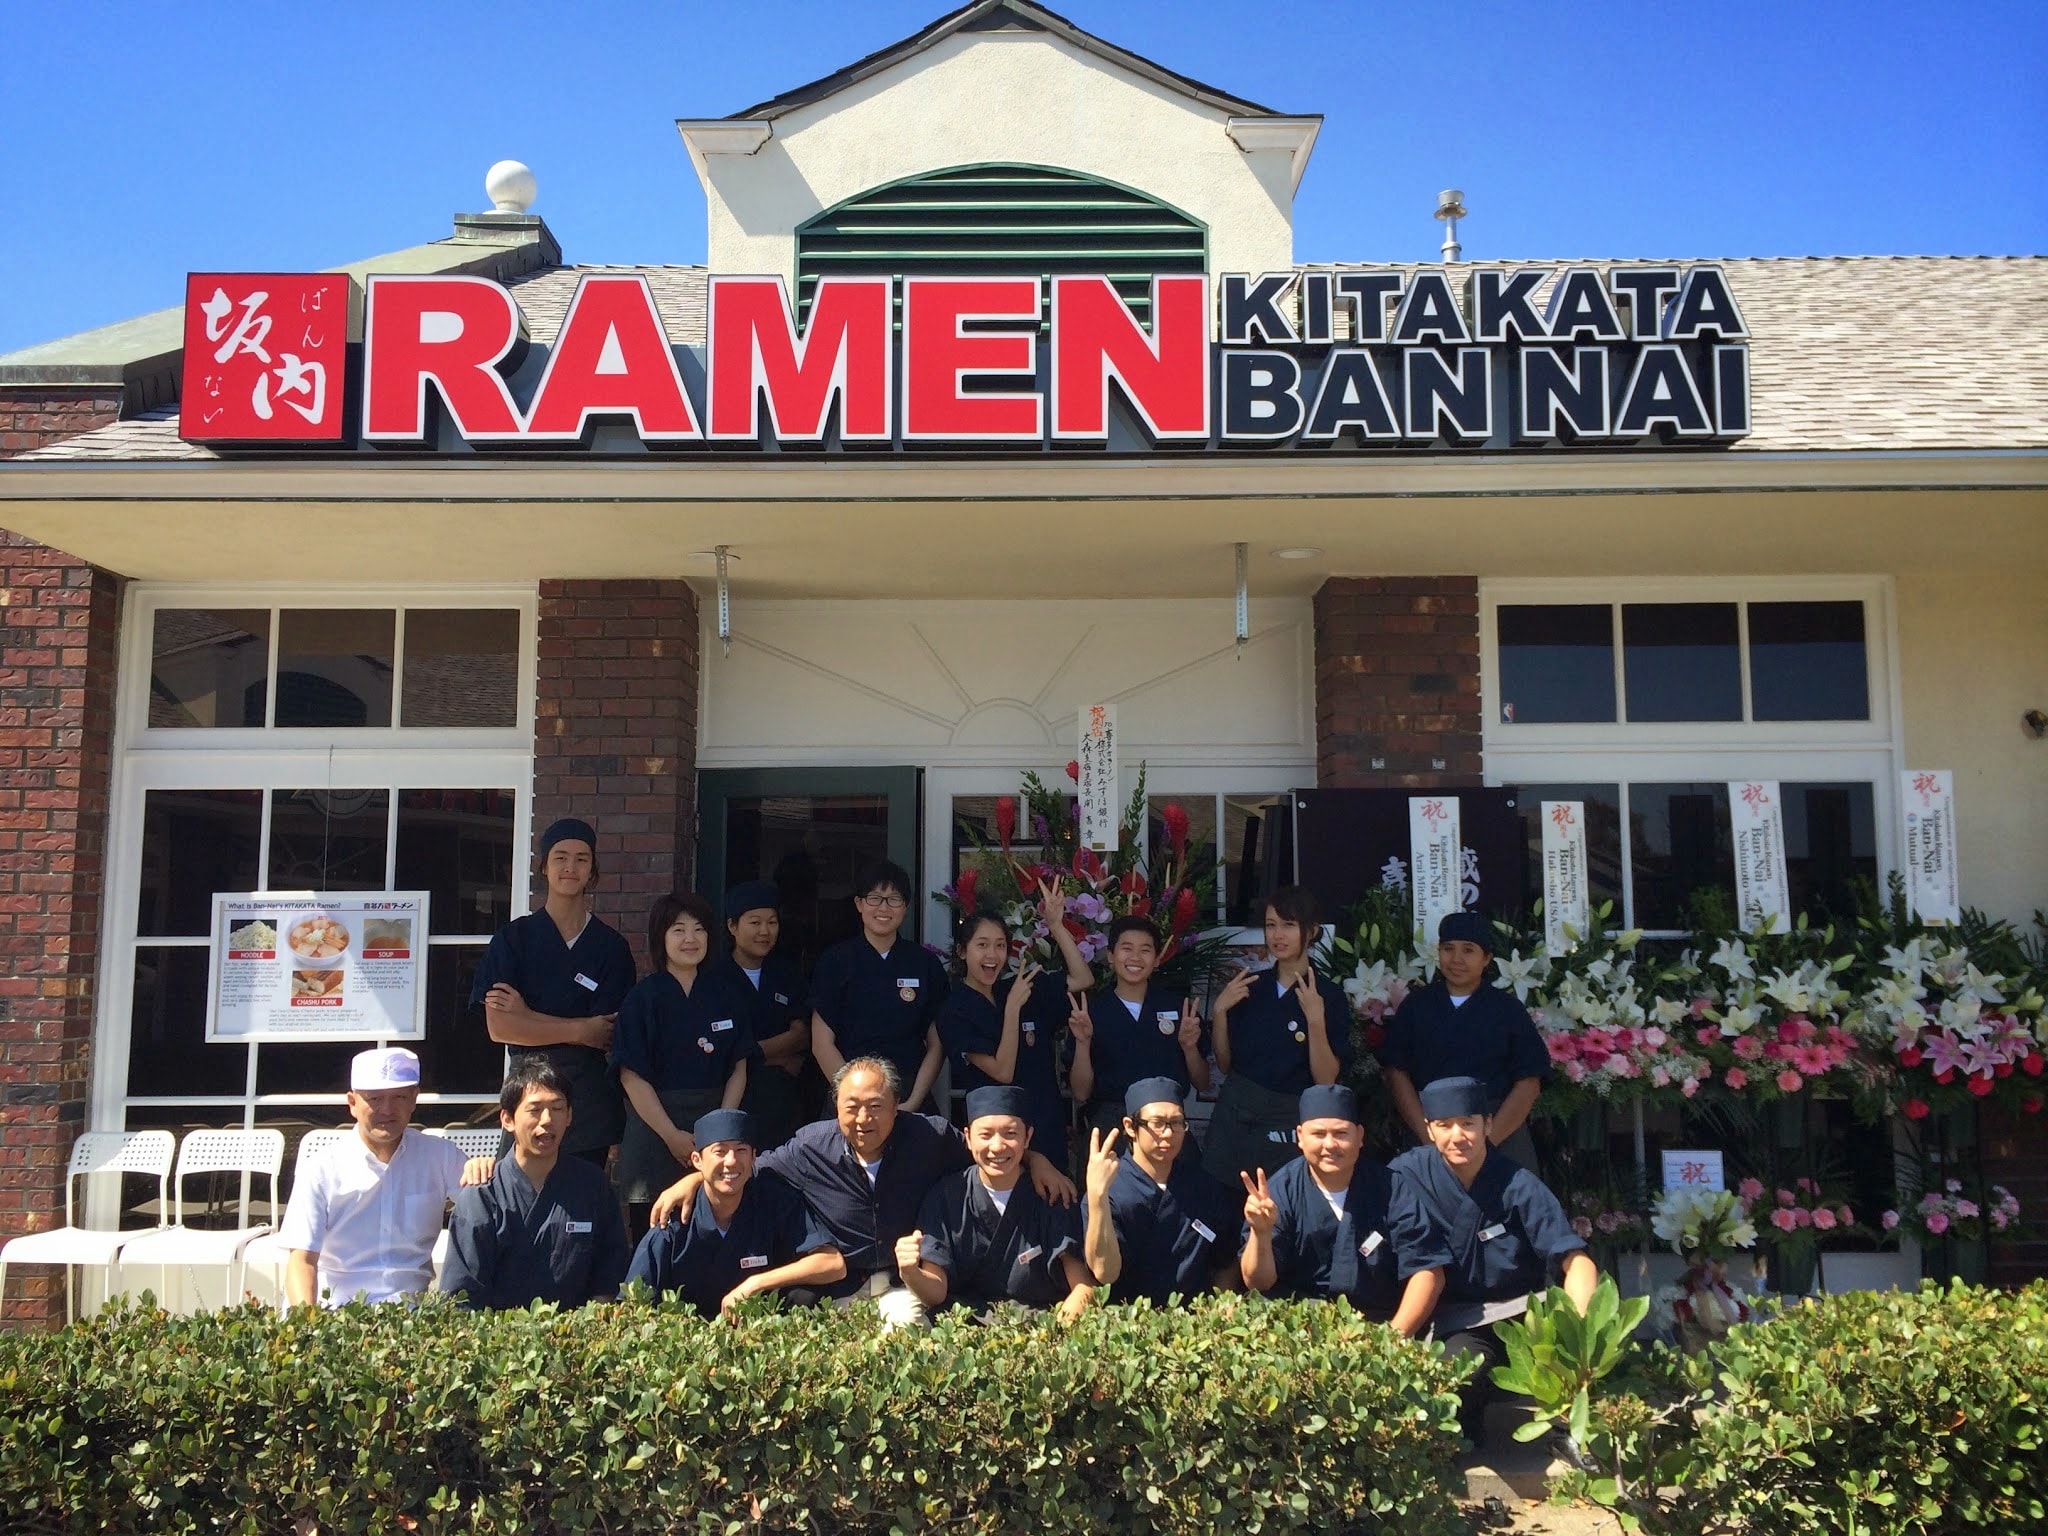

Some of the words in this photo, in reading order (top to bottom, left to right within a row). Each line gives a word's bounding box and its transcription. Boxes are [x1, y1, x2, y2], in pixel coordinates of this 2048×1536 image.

[1221, 266, 1750, 344] KITAKATA
[362, 273, 1210, 440] RAMEN
[1741, 783, 1769, 804] 祝
[1913, 773, 1941, 793] 祝
[1421, 799, 1448, 820] 祝
[1552, 804, 1575, 824] 祝
[1416, 852, 1426, 873] Arai
[1738, 830, 1750, 888] Nishimoto
[1752, 828, 1767, 882] Ban-Nai
[1908, 826, 1919, 865] Mutual
[1922, 818, 1936, 873] Ban-Nai
[1429, 843, 1442, 897] Ban-Nai
[1560, 849, 1572, 904] Ban-Nai
[1417, 876, 1427, 916] Mitchell
[1680, 1161, 1711, 1184] 祝
